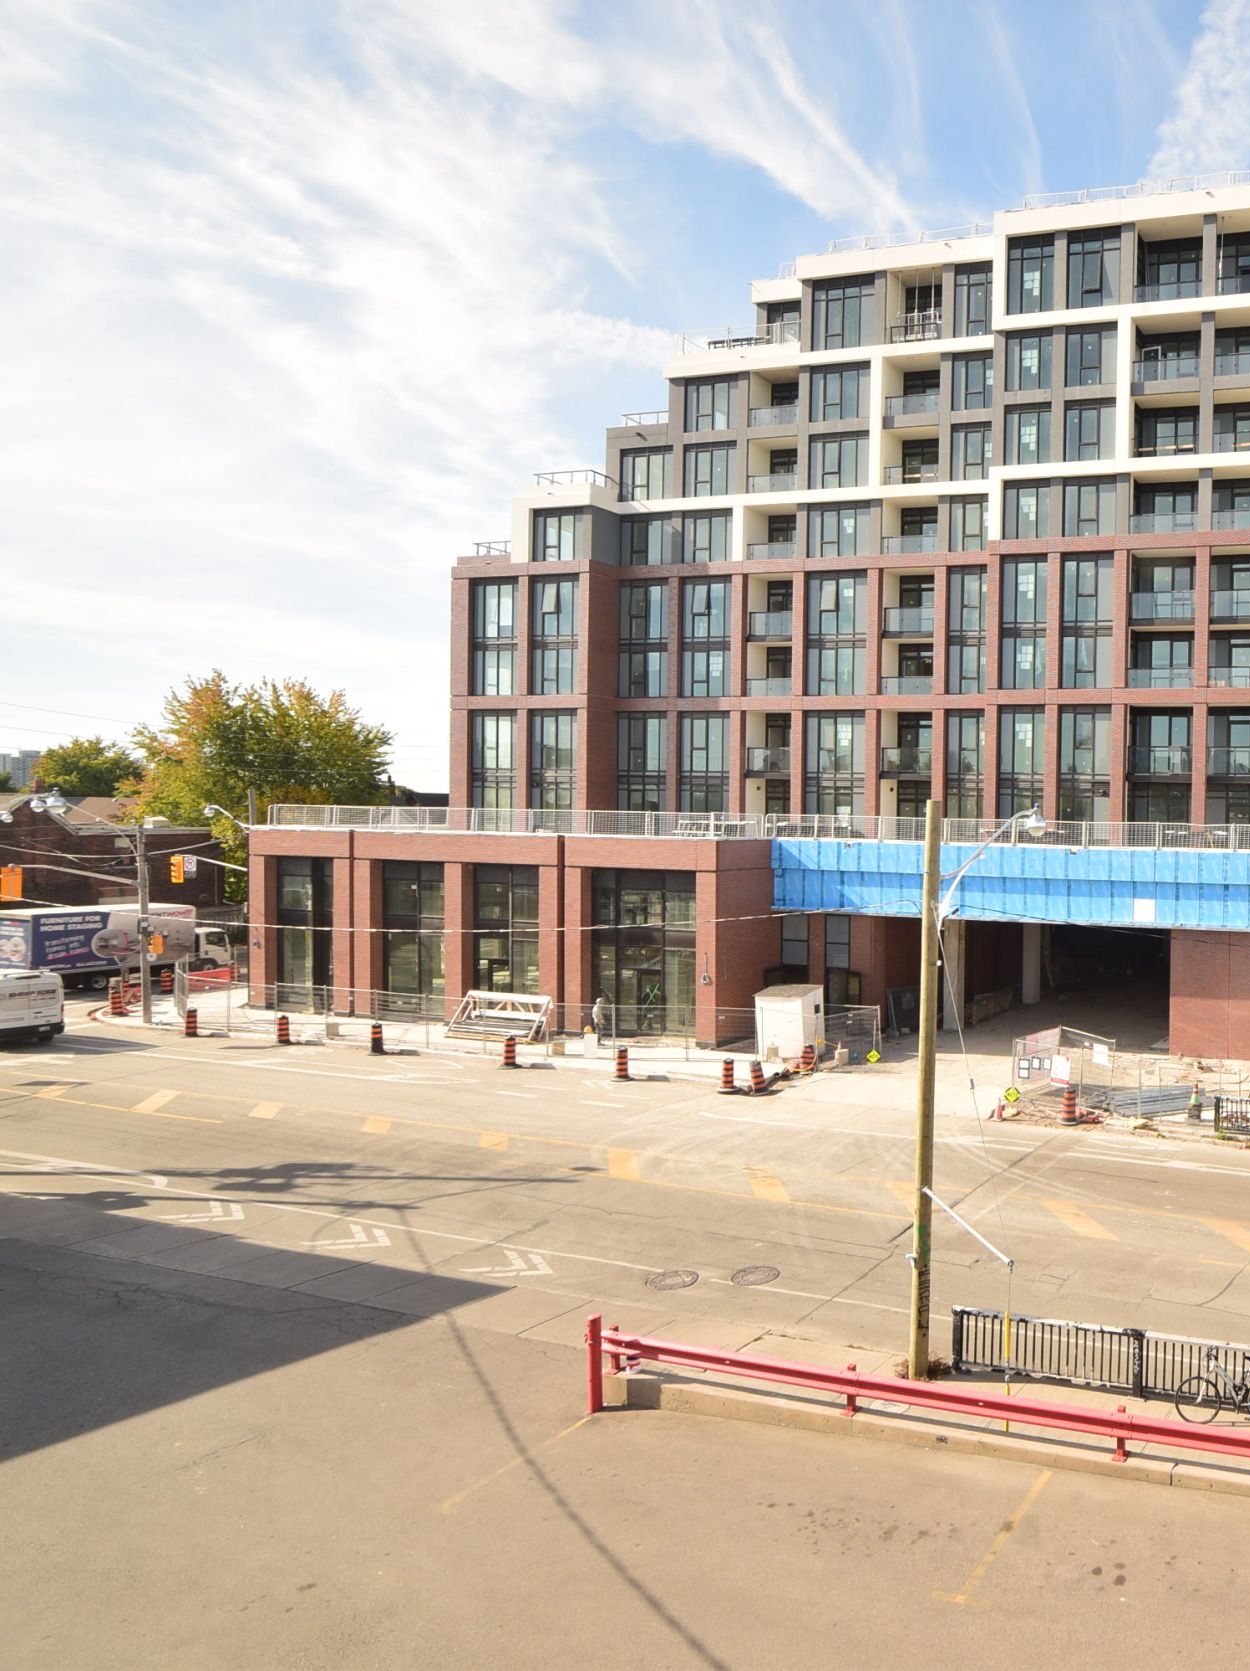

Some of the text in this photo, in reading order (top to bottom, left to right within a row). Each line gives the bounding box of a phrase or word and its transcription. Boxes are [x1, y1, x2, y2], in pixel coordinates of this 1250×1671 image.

[40, 916, 84, 924] FURNITURE
[40, 922, 104, 932] HOME STAGING
